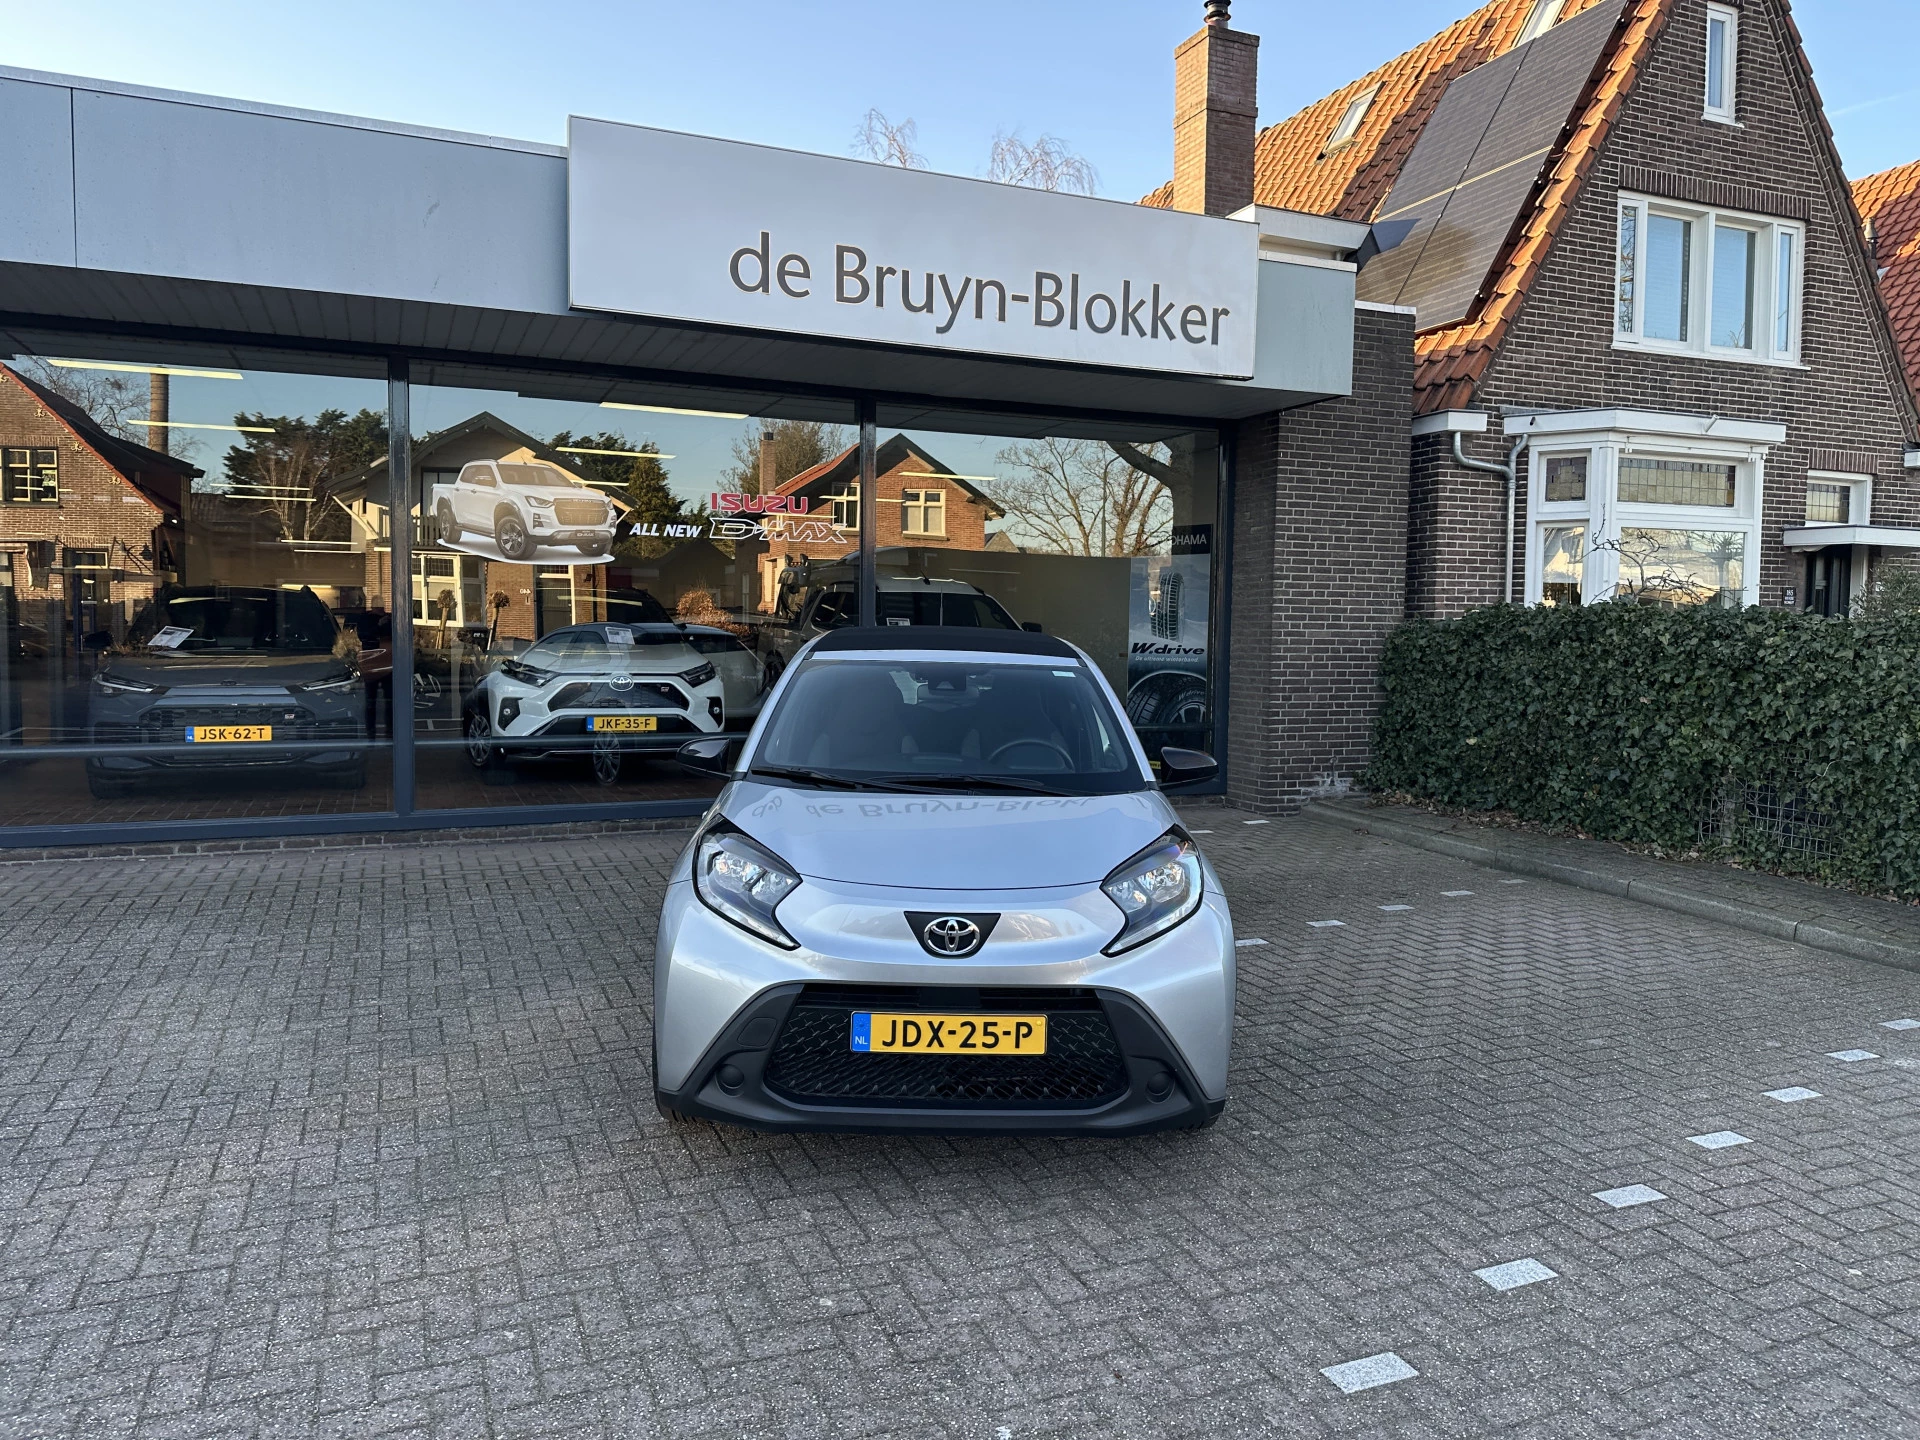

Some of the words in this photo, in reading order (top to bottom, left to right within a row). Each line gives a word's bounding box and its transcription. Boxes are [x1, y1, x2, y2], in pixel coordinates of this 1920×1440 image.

[729, 231, 812, 298] de
[834, 244, 1230, 345] Bruyn-Blokker
[711, 492, 808, 514] ISUZU
[629, 522, 660, 537] ALL
[663, 524, 702, 538] NEW
[1131, 642, 1205, 655] W.drive
[598, 718, 651, 729] JKF-35-F
[200, 727, 266, 741] JSK-62-T
[854, 1035, 869, 1046] NL
[881, 1019, 1034, 1050] JDX-25-P
